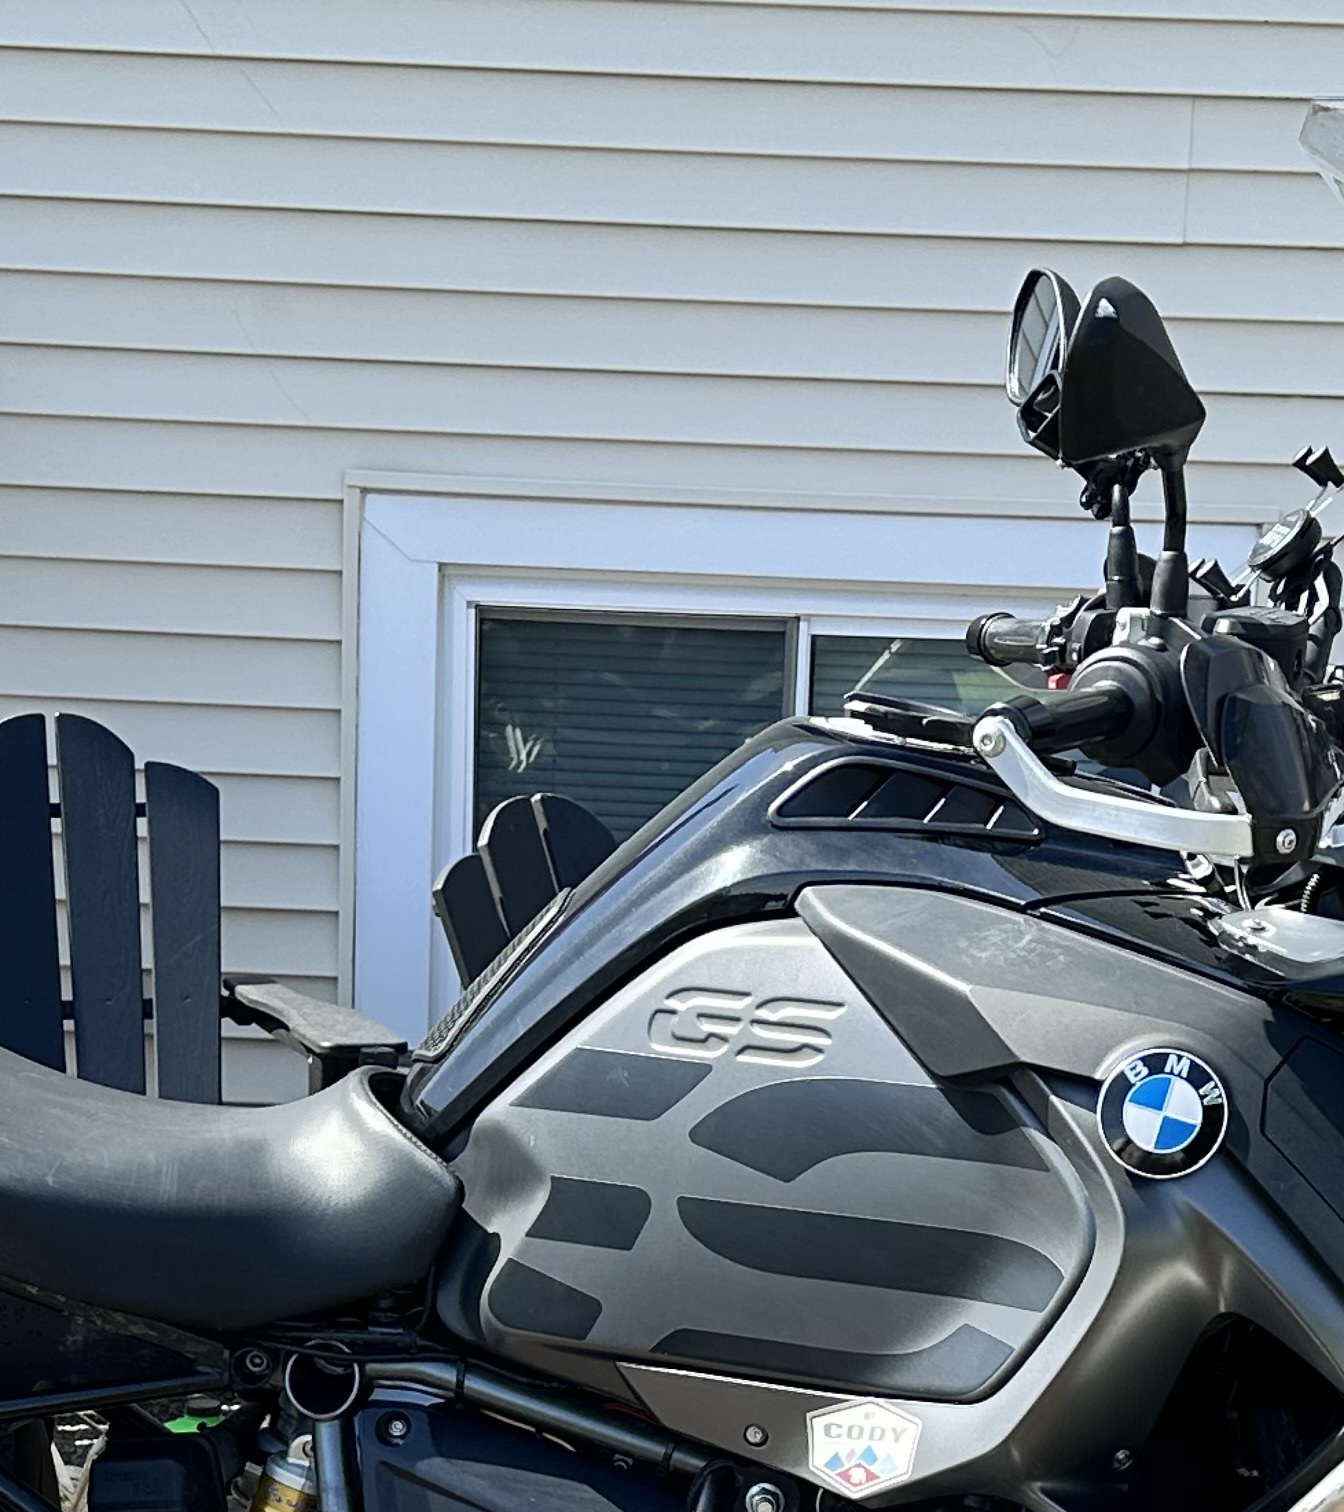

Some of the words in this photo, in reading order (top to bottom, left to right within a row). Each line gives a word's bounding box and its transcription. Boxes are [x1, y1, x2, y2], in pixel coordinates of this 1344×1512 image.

[647, 986, 848, 1068] GS
[1123, 1053, 1223, 1106] BMW
[823, 1422, 909, 1444] CODY
